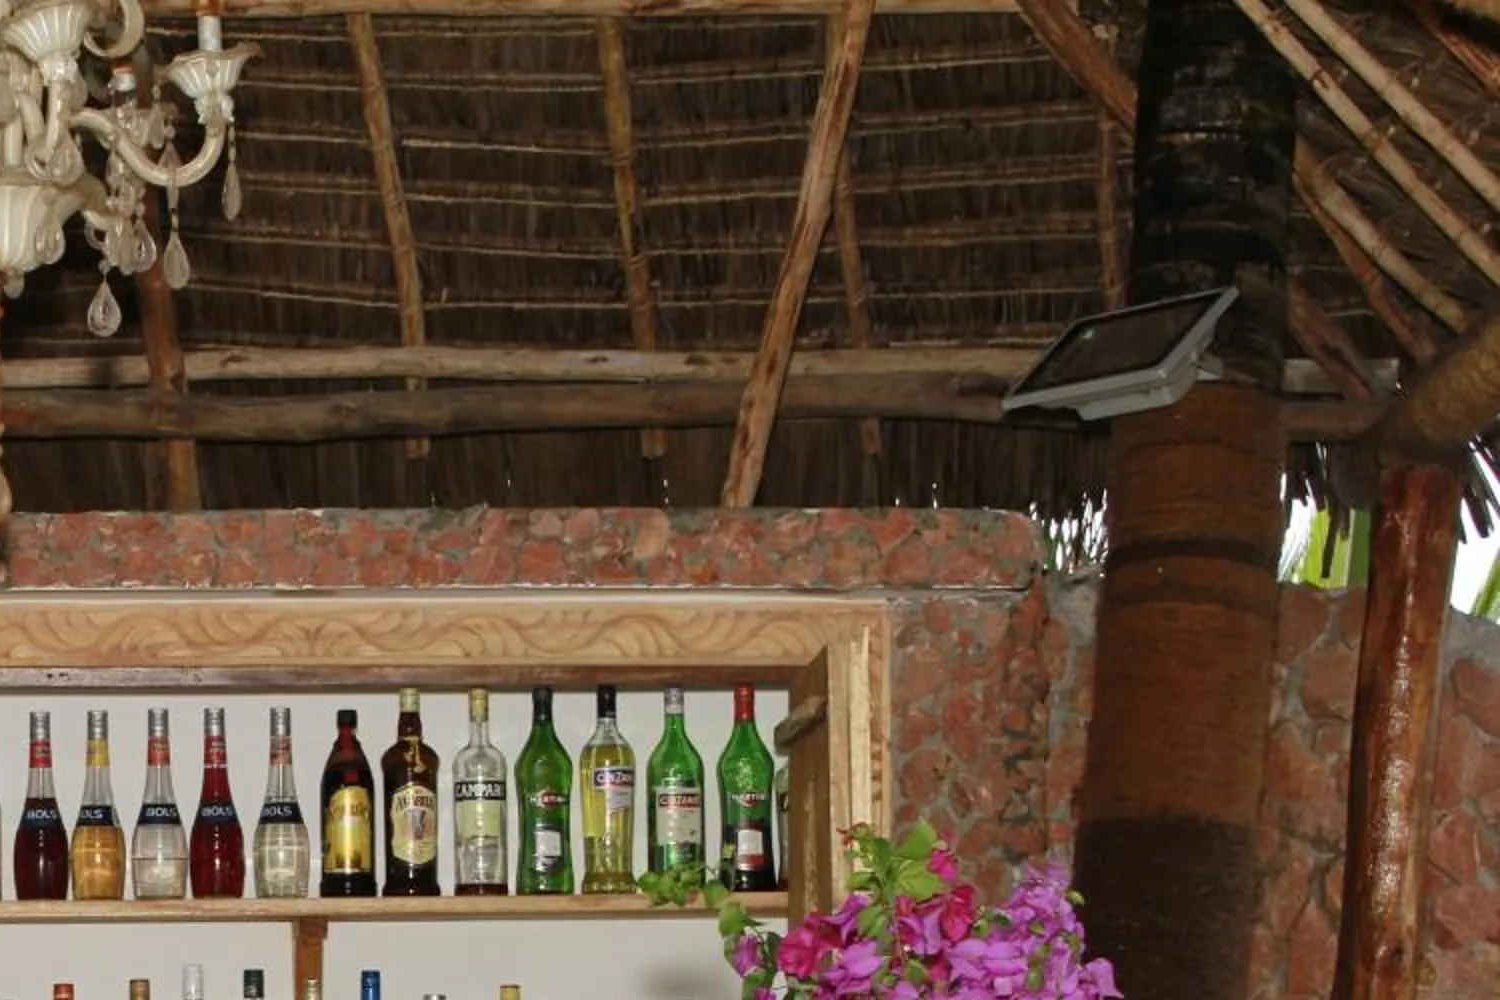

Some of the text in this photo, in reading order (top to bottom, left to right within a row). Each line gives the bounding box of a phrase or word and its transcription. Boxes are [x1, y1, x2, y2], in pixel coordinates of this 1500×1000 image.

[456, 783, 504, 798] CAMPARI
[146, 807, 177, 817] BOLS
[202, 806, 234, 816] BOLS
